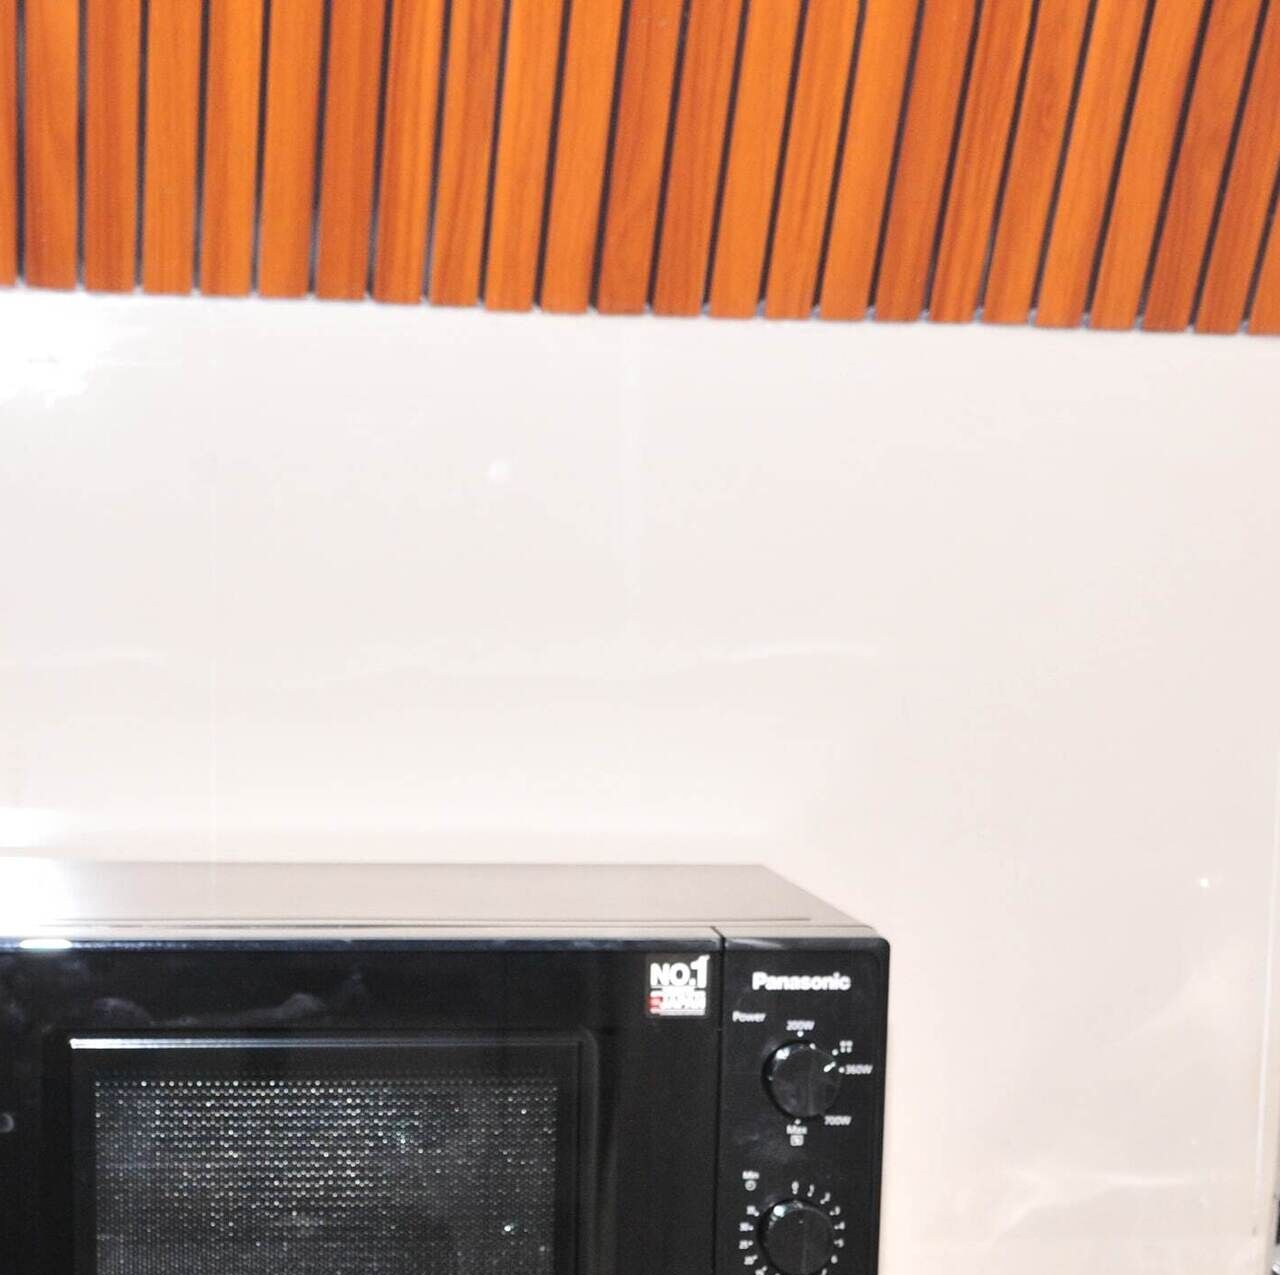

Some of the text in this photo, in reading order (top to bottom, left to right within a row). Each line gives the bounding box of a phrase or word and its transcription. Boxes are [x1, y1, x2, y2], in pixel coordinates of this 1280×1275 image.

[650, 954, 710, 988] NO.1
[752, 970, 851, 991] Panasonic
[732, 1010, 766, 1023] Power
